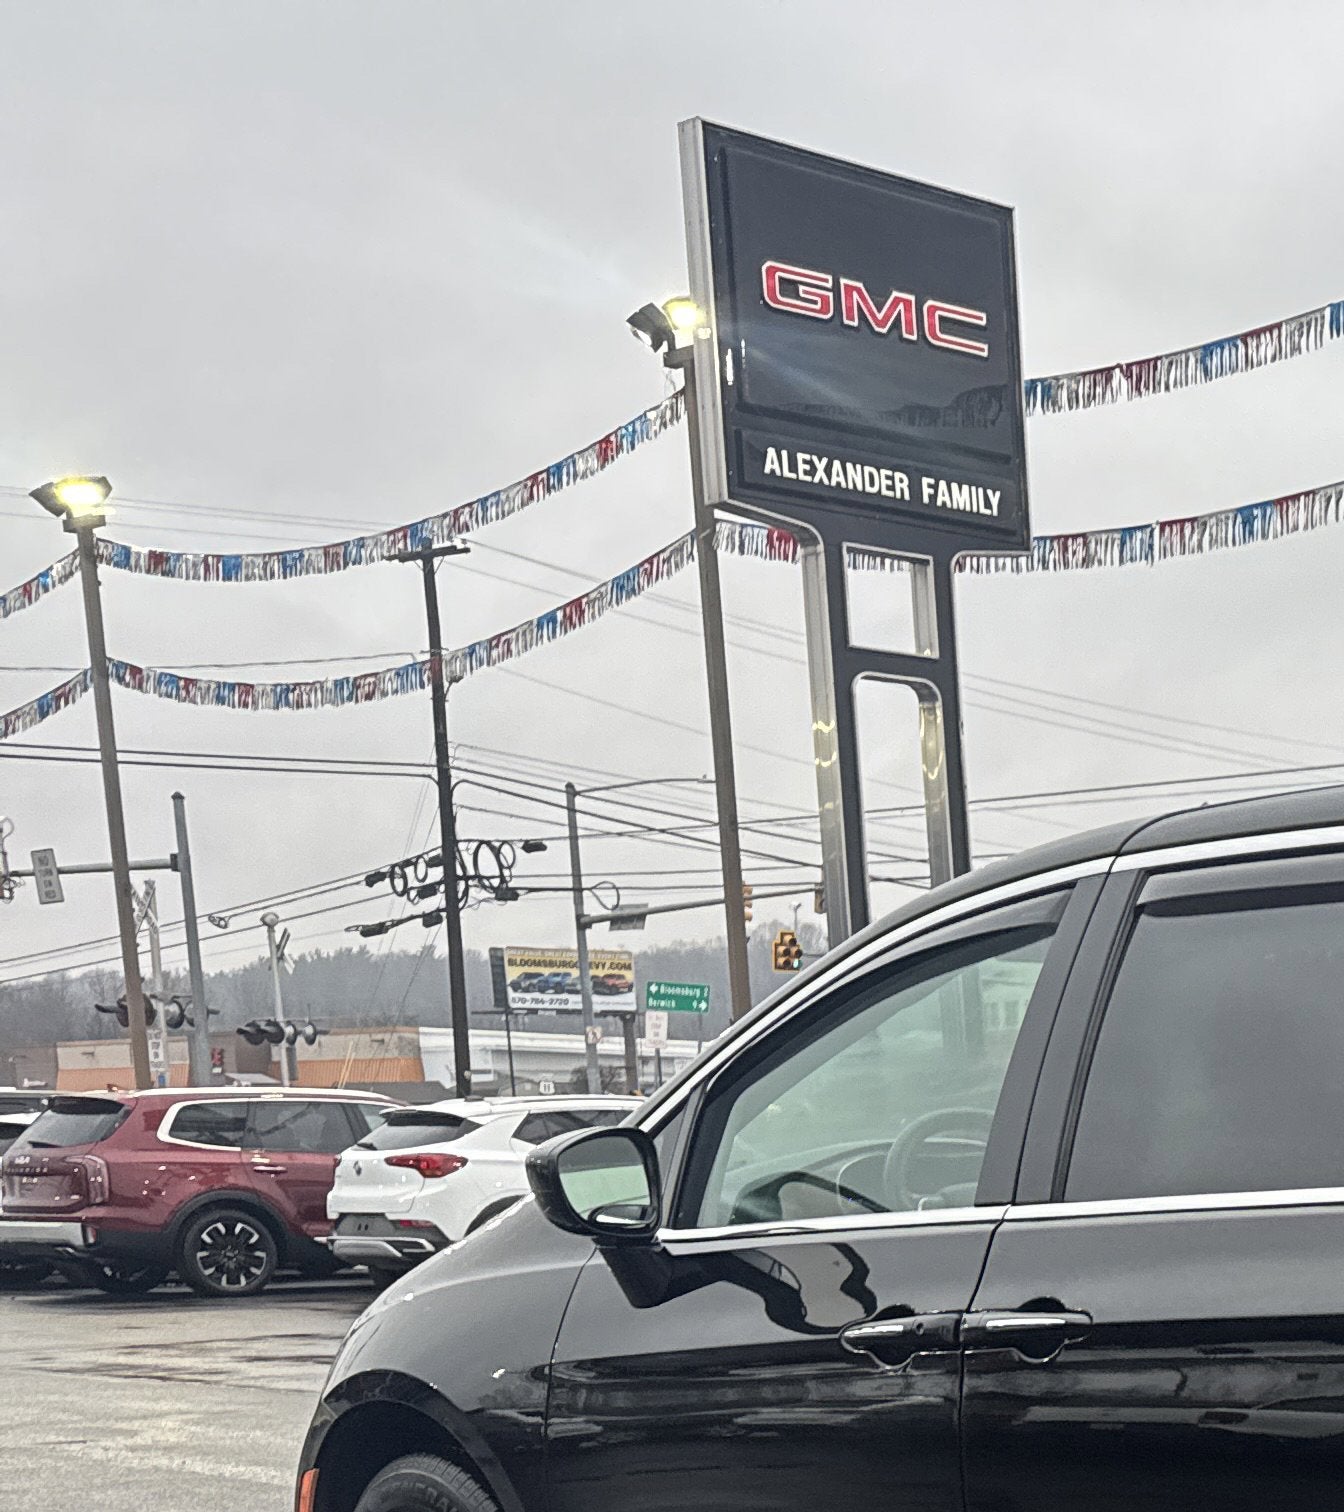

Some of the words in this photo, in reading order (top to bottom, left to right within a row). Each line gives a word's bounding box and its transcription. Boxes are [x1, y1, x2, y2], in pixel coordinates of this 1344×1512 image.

[761, 260, 989, 358] GMC
[763, 446, 911, 501] ALEXANDER
[921, 476, 1001, 517] FAMILY
[507, 958, 632, 971] BLOOMSBURGCEVY.COM
